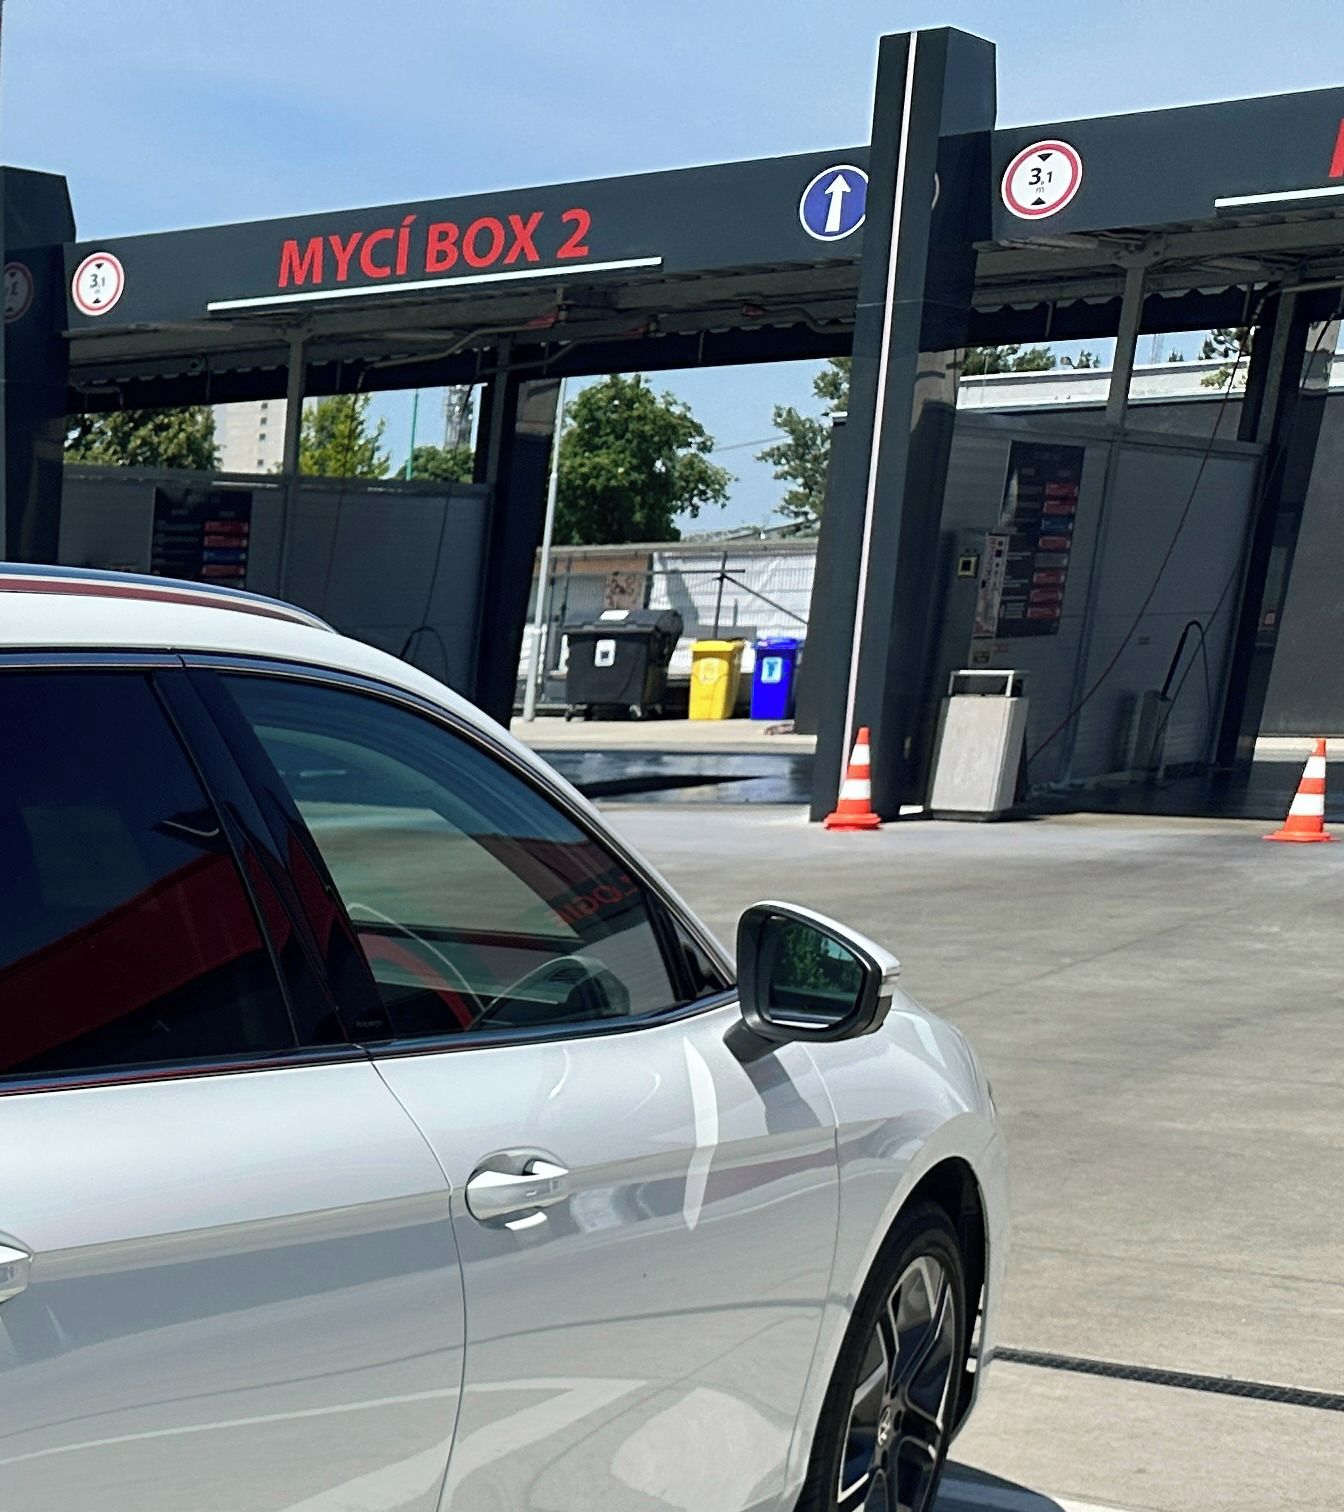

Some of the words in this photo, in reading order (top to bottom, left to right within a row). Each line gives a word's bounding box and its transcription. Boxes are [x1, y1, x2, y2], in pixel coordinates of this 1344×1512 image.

[278, 215, 415, 288] MYCÍ
[426, 212, 542, 273] BOX
[556, 208, 591, 259] 2
